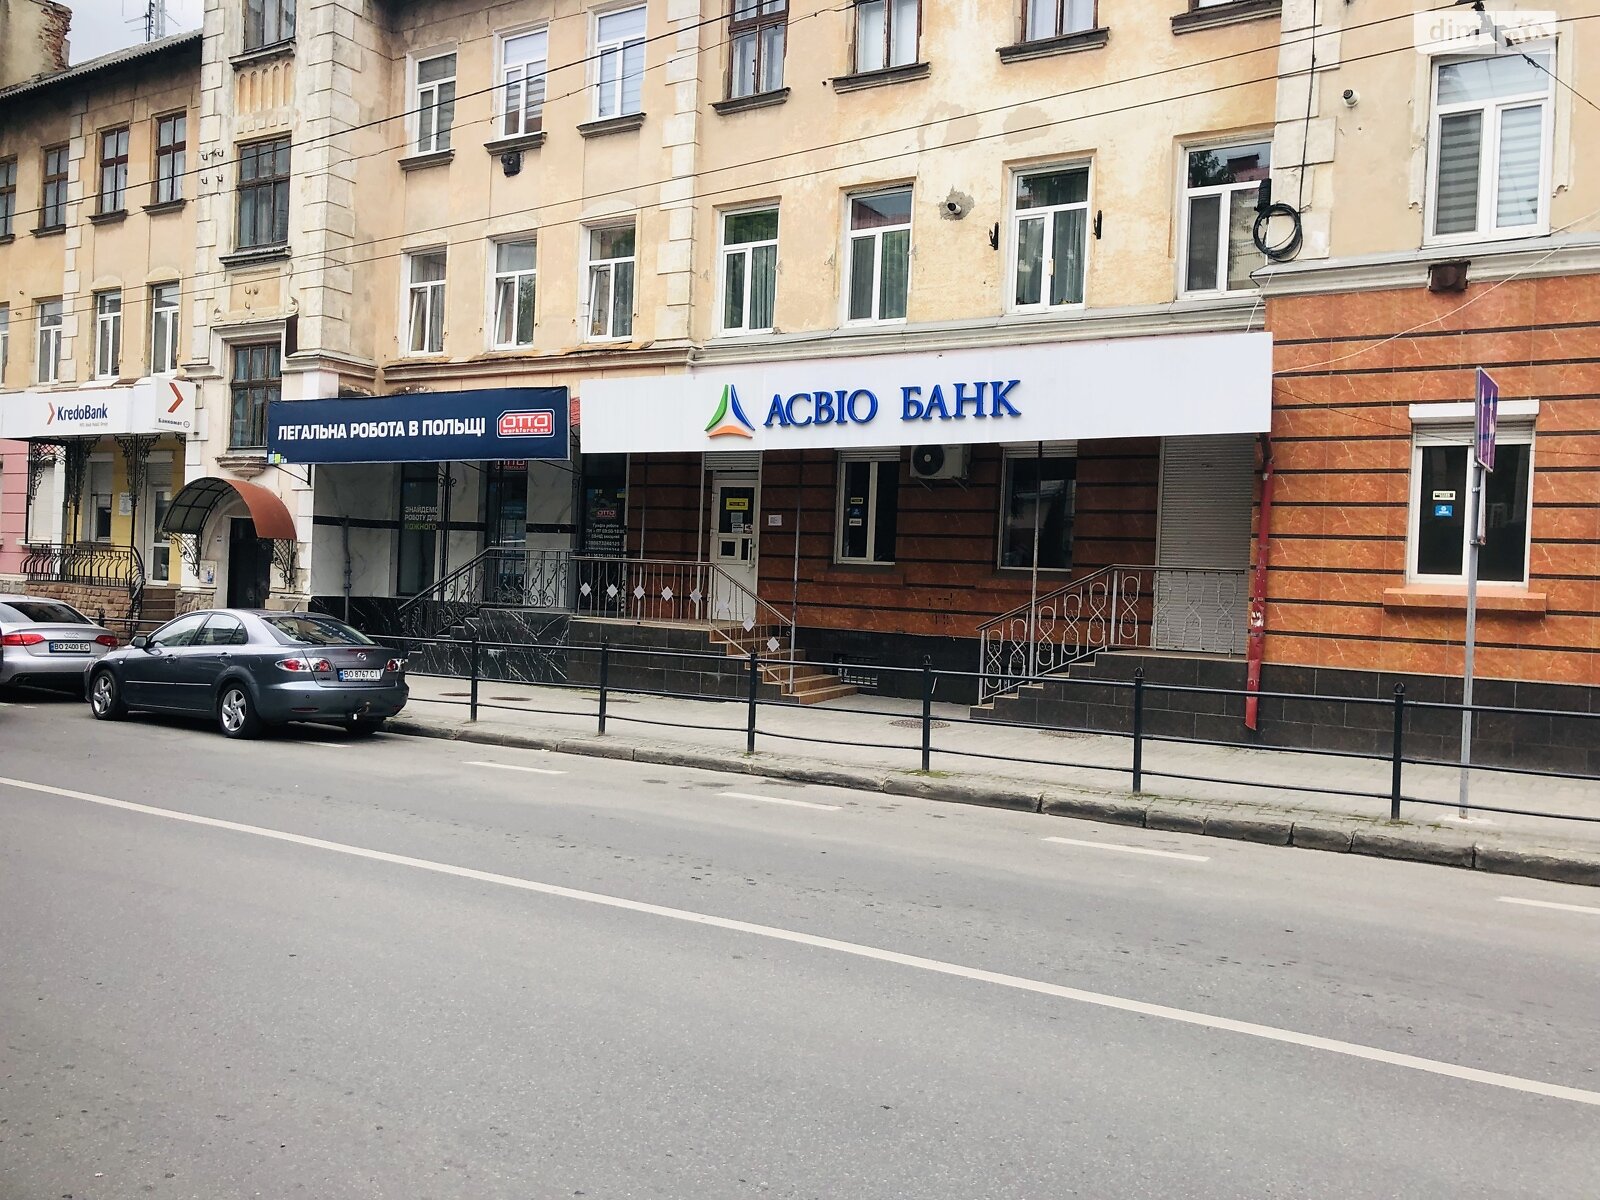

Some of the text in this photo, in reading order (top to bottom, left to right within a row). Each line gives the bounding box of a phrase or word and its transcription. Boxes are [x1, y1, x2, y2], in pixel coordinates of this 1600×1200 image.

[57, 402, 108, 421] KredoBank
[763, 380, 1022, 427] АСВІО БАНК
[158, 417, 182, 426] Банкомат
[278, 417, 486, 441] ЛЕГАЛЬНА РОБОТА В ПОЛЬЩІ
[502, 414, 548, 428] OTTO
[344, 670, 354, 678] BO
[355, 670, 368, 678] 8767
